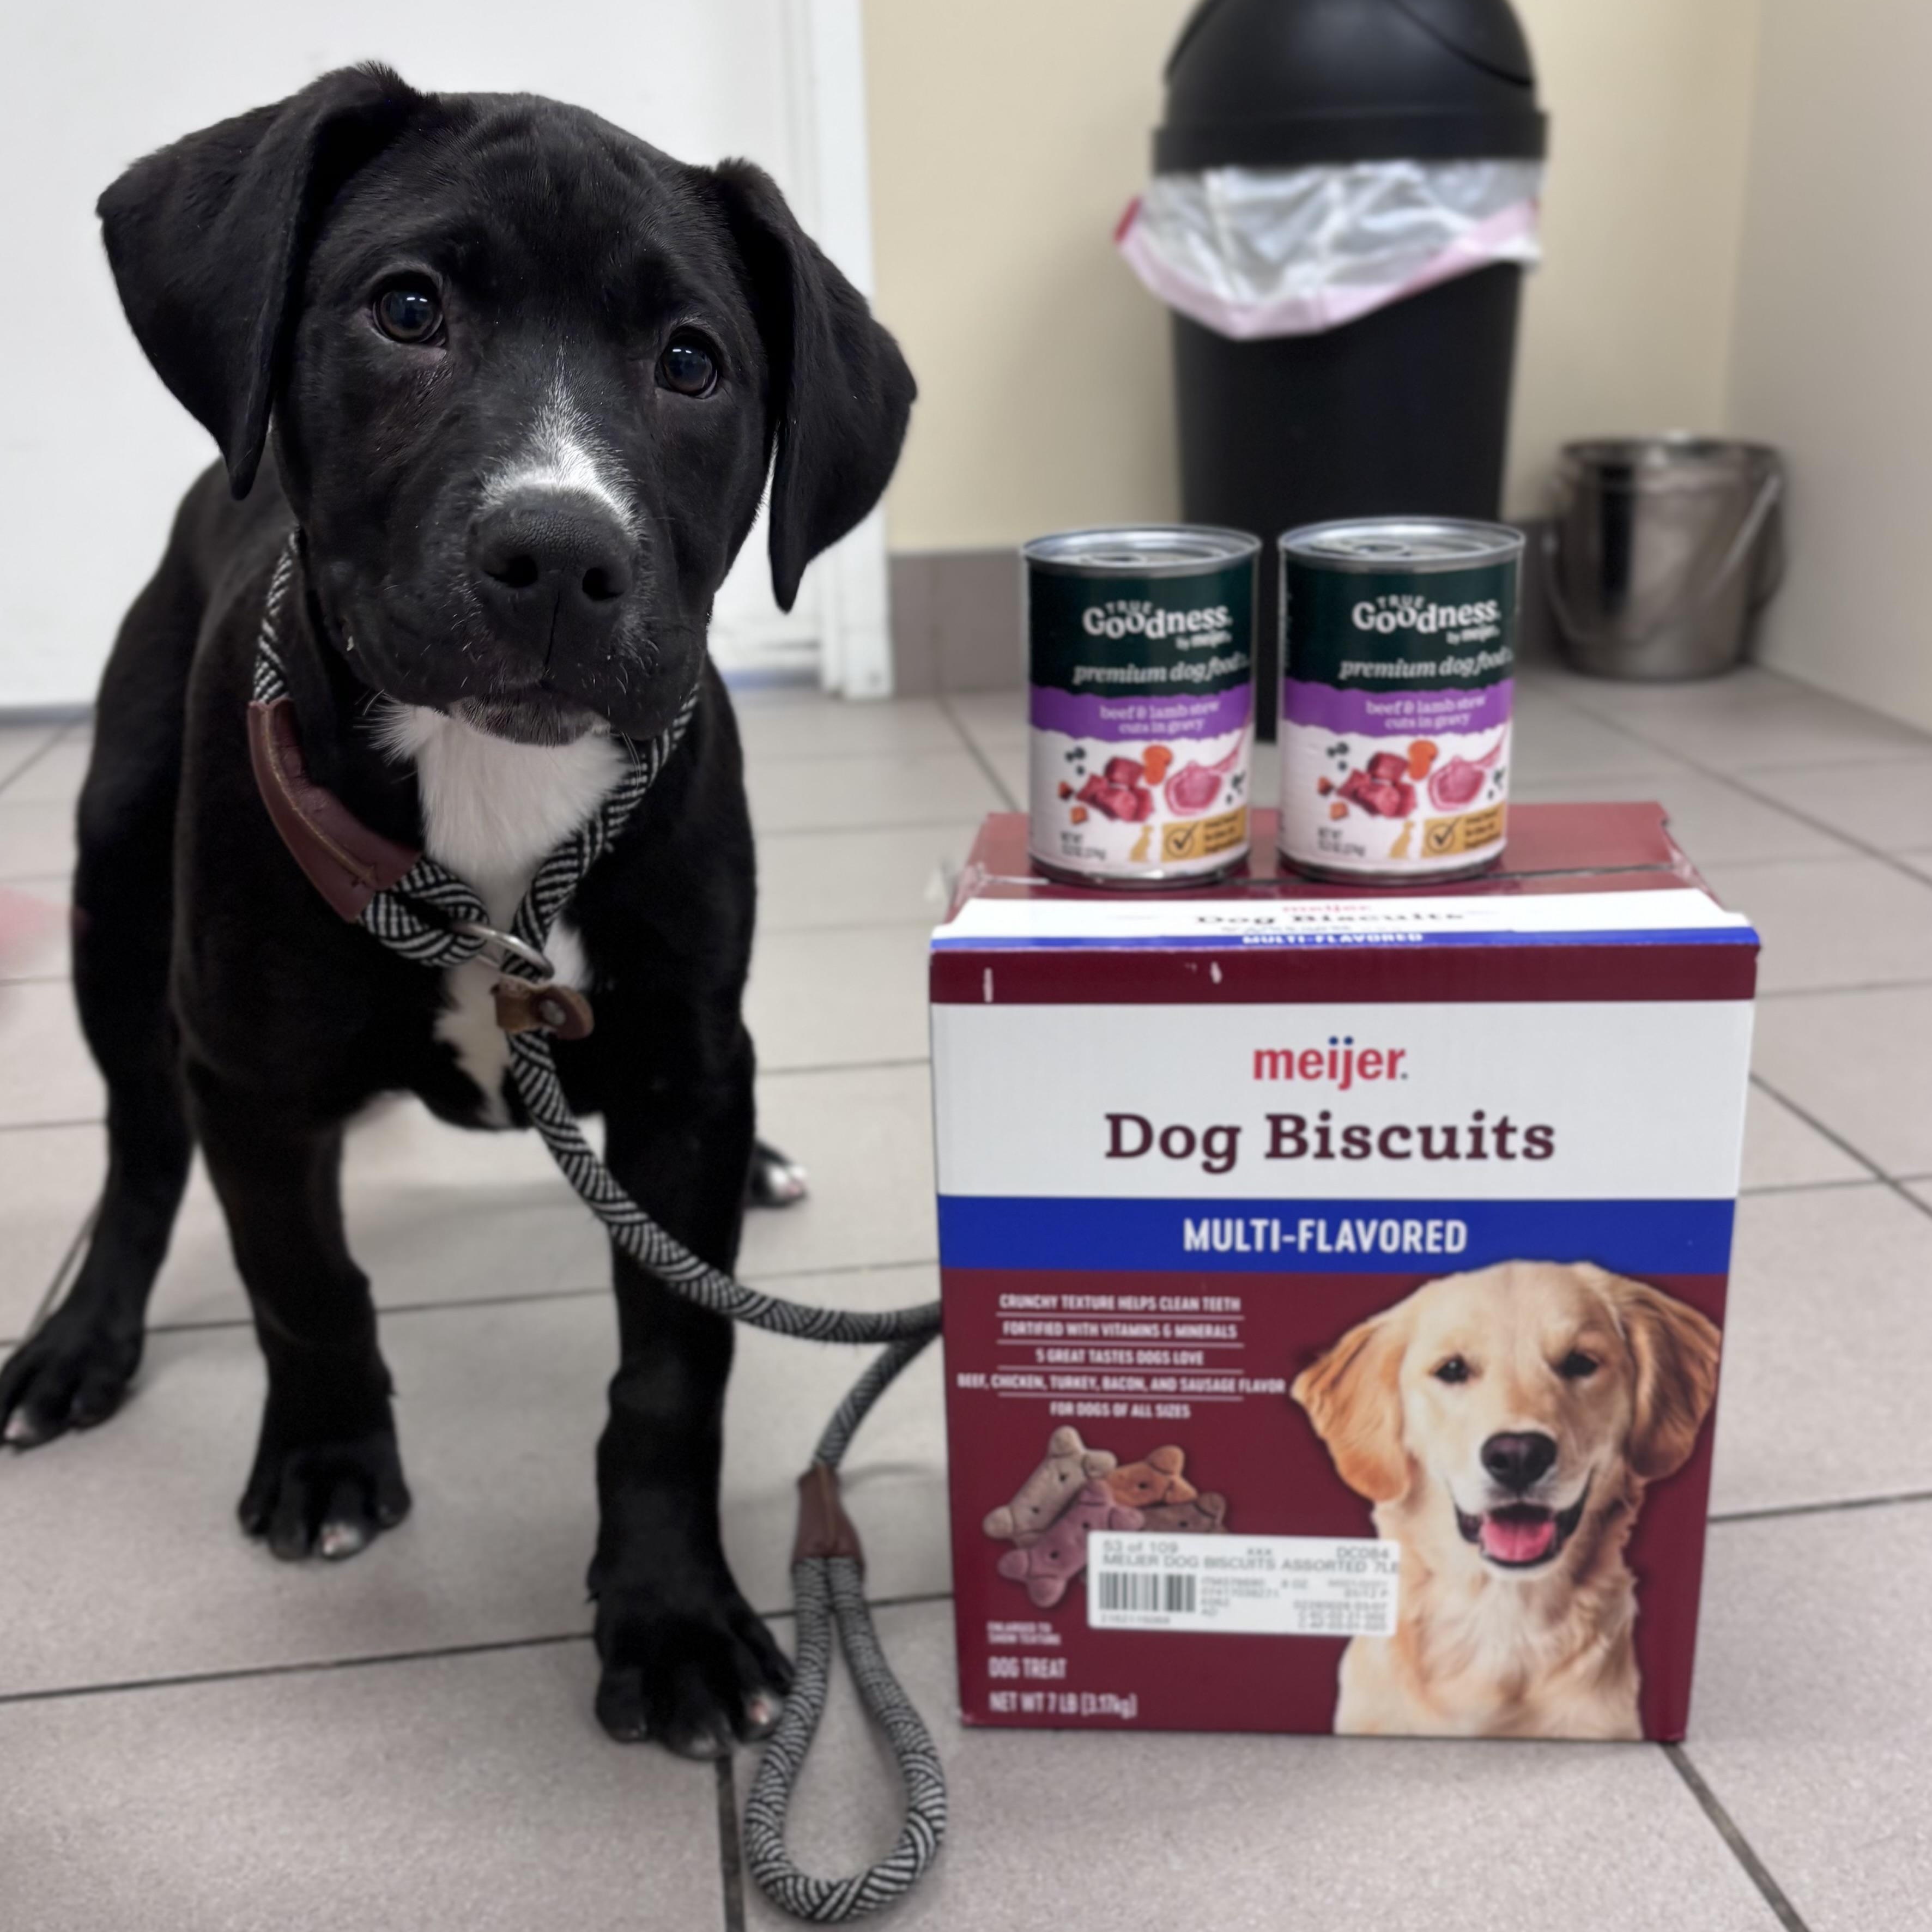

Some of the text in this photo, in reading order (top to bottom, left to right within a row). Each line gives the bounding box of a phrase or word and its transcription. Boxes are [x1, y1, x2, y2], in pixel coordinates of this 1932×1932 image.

[1106, 601, 1153, 615] TRUE
[1377, 595, 1424, 609] TRUE
[1072, 663, 1167, 685] premium
[1170, 662, 1206, 682] dog
[1339, 658, 1437, 680] premium
[1439, 656, 1475, 677] dog
[1100, 701, 1220, 719] beef & lamb stew
[1366, 695, 1486, 714] beef & lamb stew
[1119, 719, 1205, 734] cuts in gravy
[1384, 713, 1471, 729] cuts in gravy
[1241, 932, 1424, 945] MULTI-FLAVORED
[1104, 1110, 1555, 1175] Dog Biscuits
[1183, 1218, 1468, 1254] MULTI-FLAVORED
[1000, 1293, 1241, 1311] CRUNCHY TEXTURE HELPS CLEAN TEETH
[1003, 1321, 1063, 1336] FORTIFIED
[1066, 1322, 1099, 1336] WITH
[1101, 1323, 1160, 1337] VITAMINS
[1174, 1324, 1237, 1339] MINERALS
[1035, 1348, 1204, 1365] 5 GREAT TASTES DOGS LOVE
[957, 1373, 1286, 1393] BEEF, CHICKEN, TURKEY, BACON, AND SAUSAGE FLAVOR
[1050, 1401, 1191, 1419] FOR DOGS OF ALL SIZES
[1127, 1541, 1143, 1553] of
[1149, 1542, 1179, 1553] 109
[1103, 1554, 1158, 1566] MEIJER
[1164, 1556, 1198, 1568] DOG
[1204, 1557, 1276, 1571] BISCUITS
[1282, 1559, 1367, 1573] ASSORTED
[988, 1657, 1067, 1679] DOG TREAT
[989, 1691, 1017, 1712] NET
[1020, 1692, 1044, 1712] WT
[1047, 1692, 1057, 1713] 7
[1059, 1693, 1079, 1713] LB
